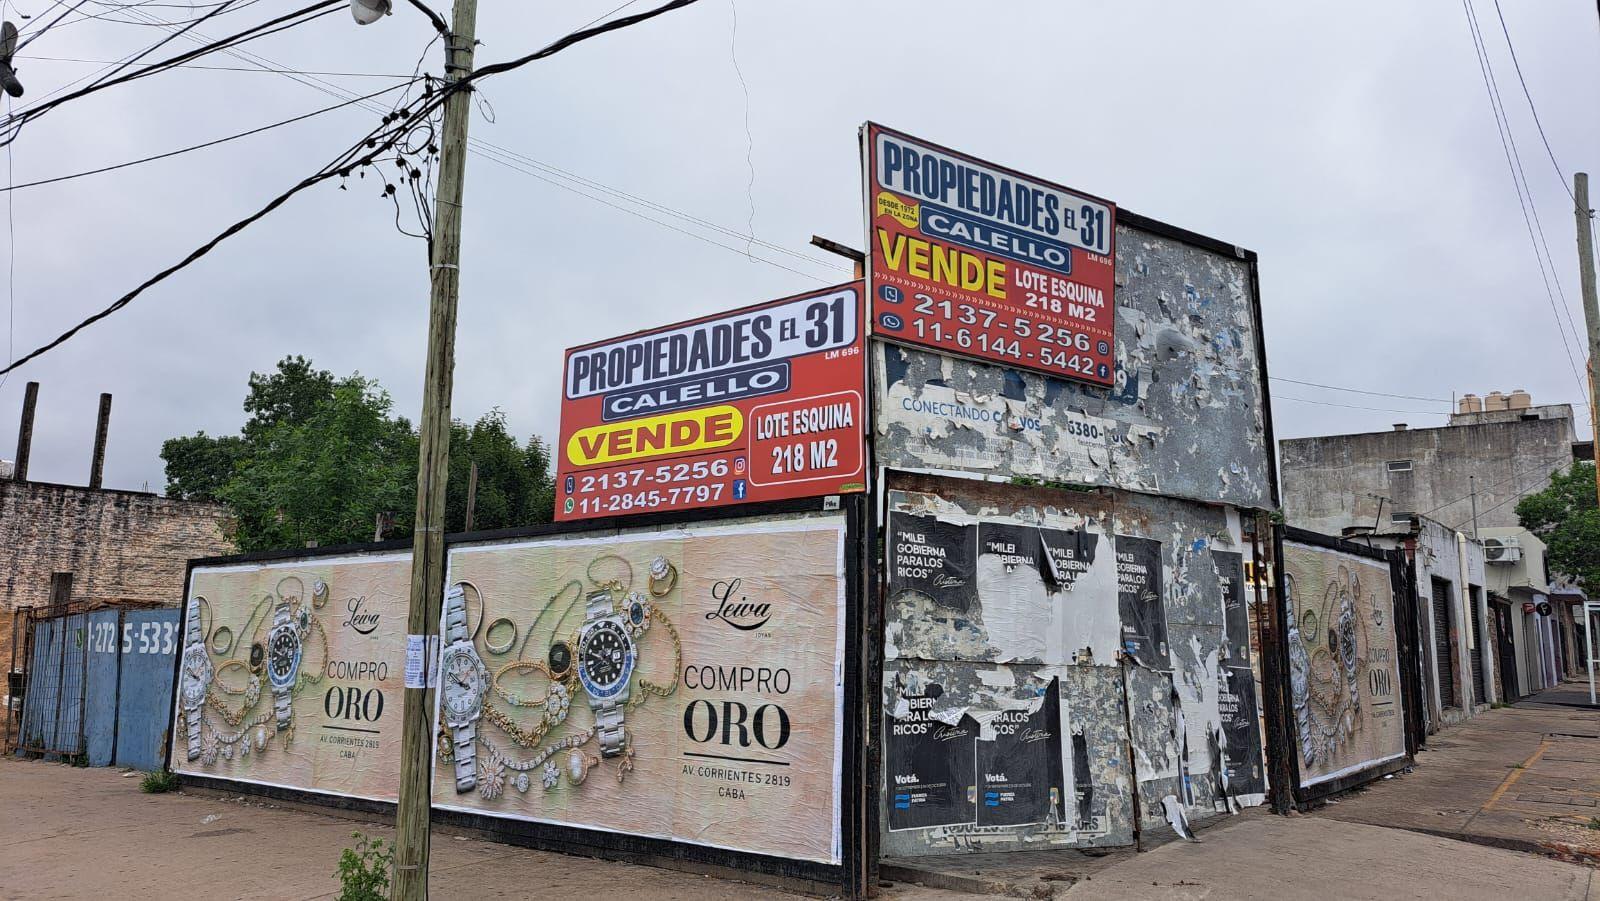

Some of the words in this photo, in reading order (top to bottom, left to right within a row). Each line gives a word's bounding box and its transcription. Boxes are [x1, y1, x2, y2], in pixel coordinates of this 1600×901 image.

[878, 198, 899, 210] DESDE
[900, 204, 915, 215] 1972
[883, 140, 1060, 237] PROPIEDADES
[1064, 208, 1077, 231] EL
[1080, 205, 1104, 250] 31
[902, 213, 918, 222] ZONA
[928, 214, 1066, 265] CALELLO
[877, 228, 1007, 299] VENDE
[1087, 252, 1098, 262] LM
[1015, 267, 1048, 294] LOTE
[1051, 278, 1104, 308] ESQUINA
[1025, 292, 1062, 315] 218
[1068, 303, 1096, 322] M2
[572, 315, 772, 395] PROPIEDADES
[779, 317, 800, 342] EL
[805, 297, 845, 349] 31
[825, 350, 839, 360] LM
[841, 346, 860, 357] 696
[610, 370, 780, 414] CALELLO
[757, 412, 789, 440] LOTE
[792, 402, 853, 436] ESQUINA
[902, 397, 990, 421] CONECTANDO
[578, 412, 734, 460] VENDE
[772, 444, 804, 474] 218
[810, 438, 838, 470] M2
[581, 458, 729, 493] 2137-5256
[579, 483, 725, 514] 11-2845-7797
[897, 543, 946, 557] GOBIERNA
[897, 555, 922, 567] PARA
[924, 557, 943, 568] LOS
[705, 578, 772, 628] Leiva
[327, 660, 388, 682] COMPRO
[684, 665, 791, 694] COMPRO
[1369, 669, 1391, 696] ORO
[324, 685, 384, 722] ORO
[684, 699, 791, 750] ORO
[1011, 713, 1029, 723] LOS
[330, 736, 364, 747] CORRIENTES
[340, 750, 355, 758] CABA
[682, 764, 695, 776] AV.
[697, 766, 762, 784] CORRIENTES
[765, 774, 791, 787] 2819
[895, 773, 919, 785] Votá.
[985, 773, 1008, 782] Votá.
[718, 787, 745, 800] CABA
